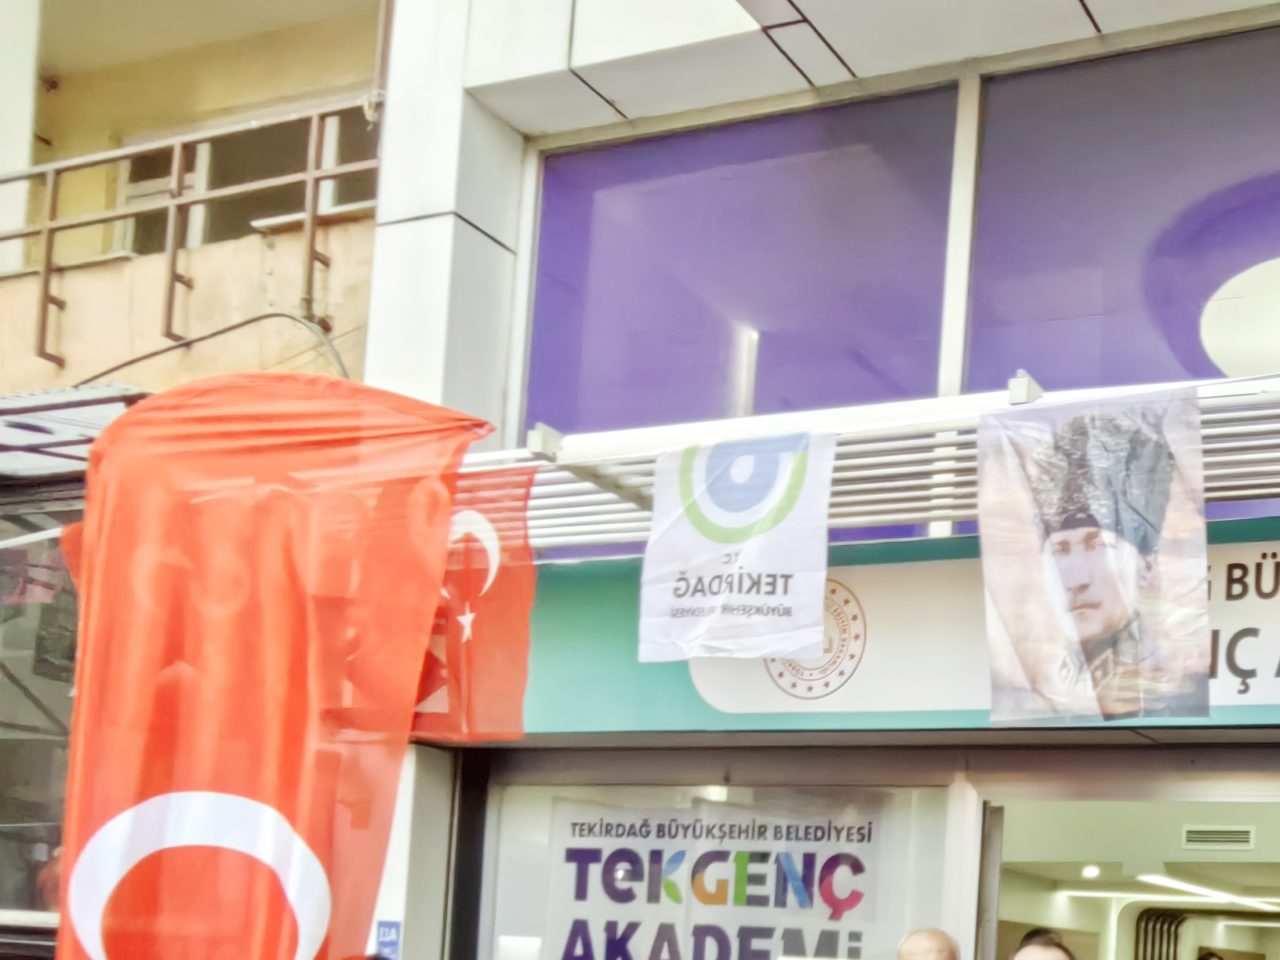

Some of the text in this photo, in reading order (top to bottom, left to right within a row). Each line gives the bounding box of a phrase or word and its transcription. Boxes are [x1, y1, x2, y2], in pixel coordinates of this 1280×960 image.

[571, 817, 873, 844] TEKİRDAĞ BÜYÜKŞEHİR BELEDİYESİ
